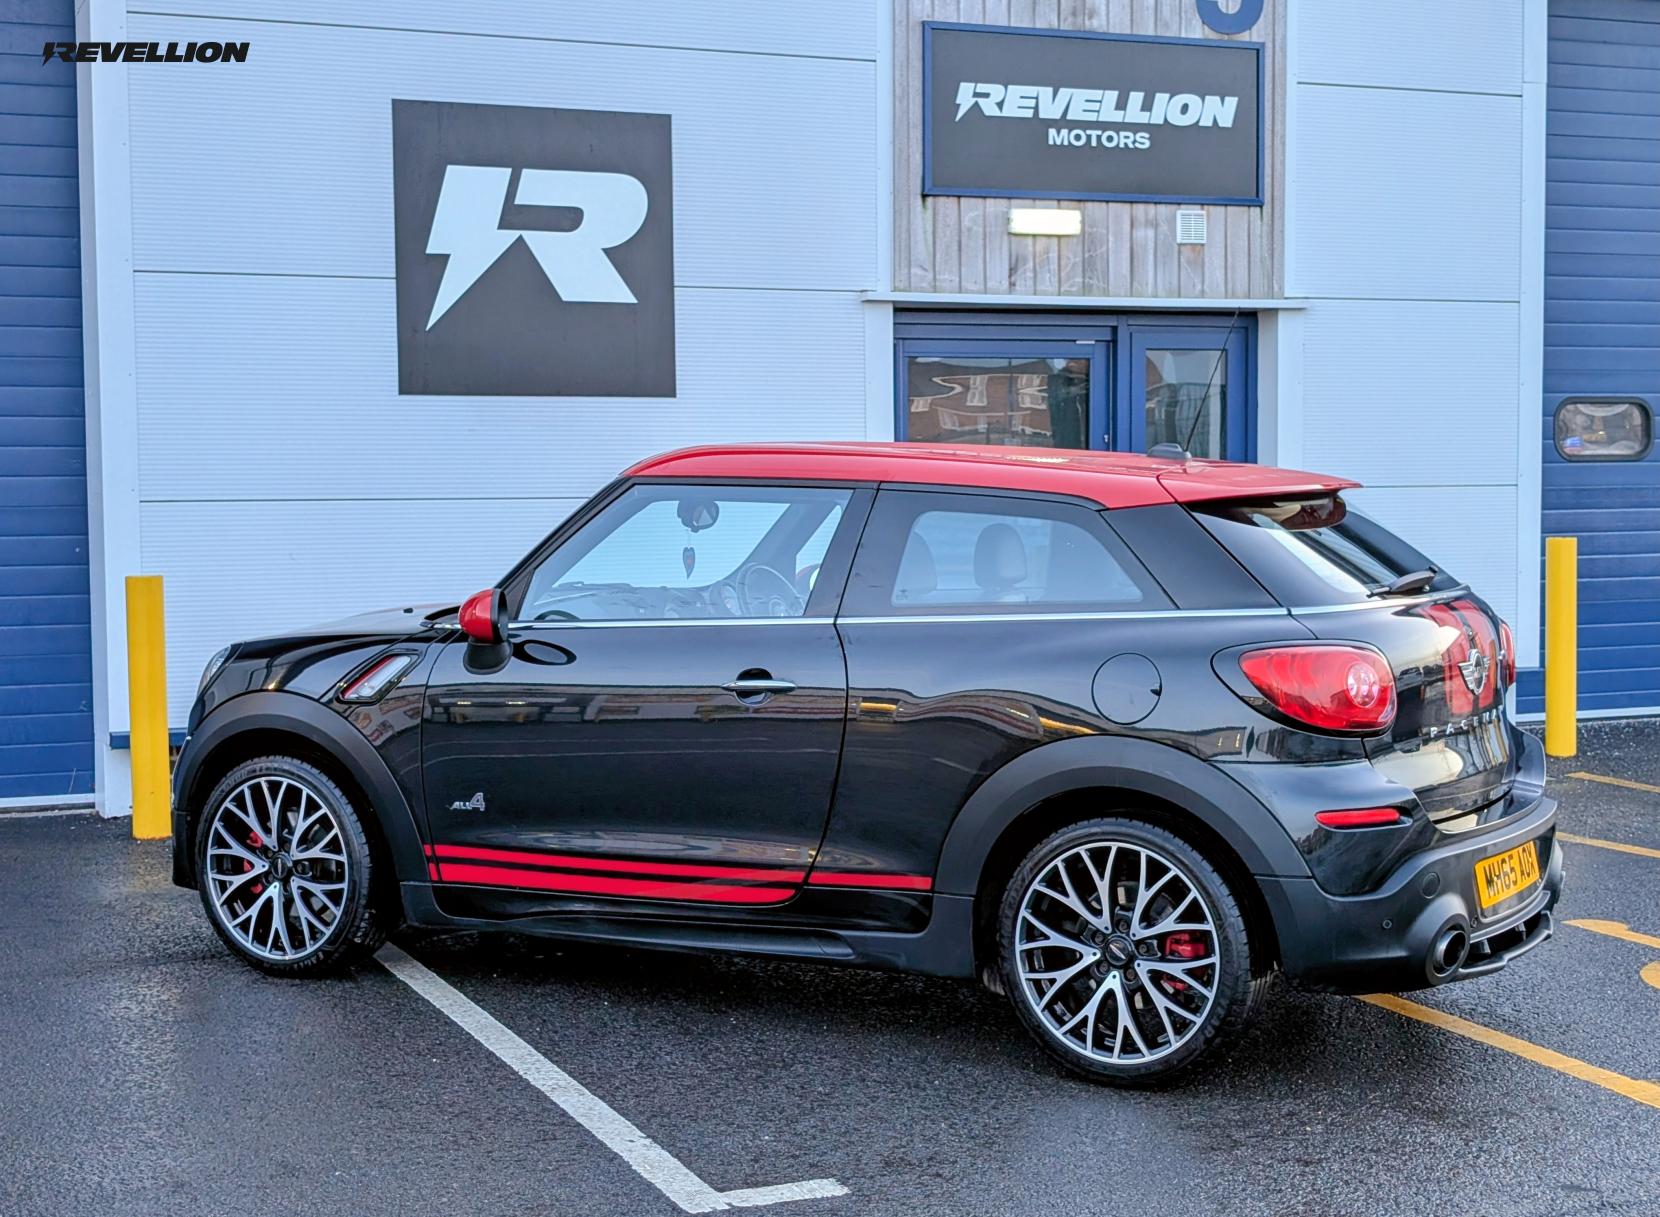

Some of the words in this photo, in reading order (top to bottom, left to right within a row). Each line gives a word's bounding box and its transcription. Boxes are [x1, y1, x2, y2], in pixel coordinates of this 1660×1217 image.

[955, 82, 1238, 128] REVELLION
[1048, 128, 1150, 149] MOTORS
[426, 165, 648, 331] R
[1430, 705, 1503, 738] PACEMA
[1483, 854, 1518, 899] MH65
